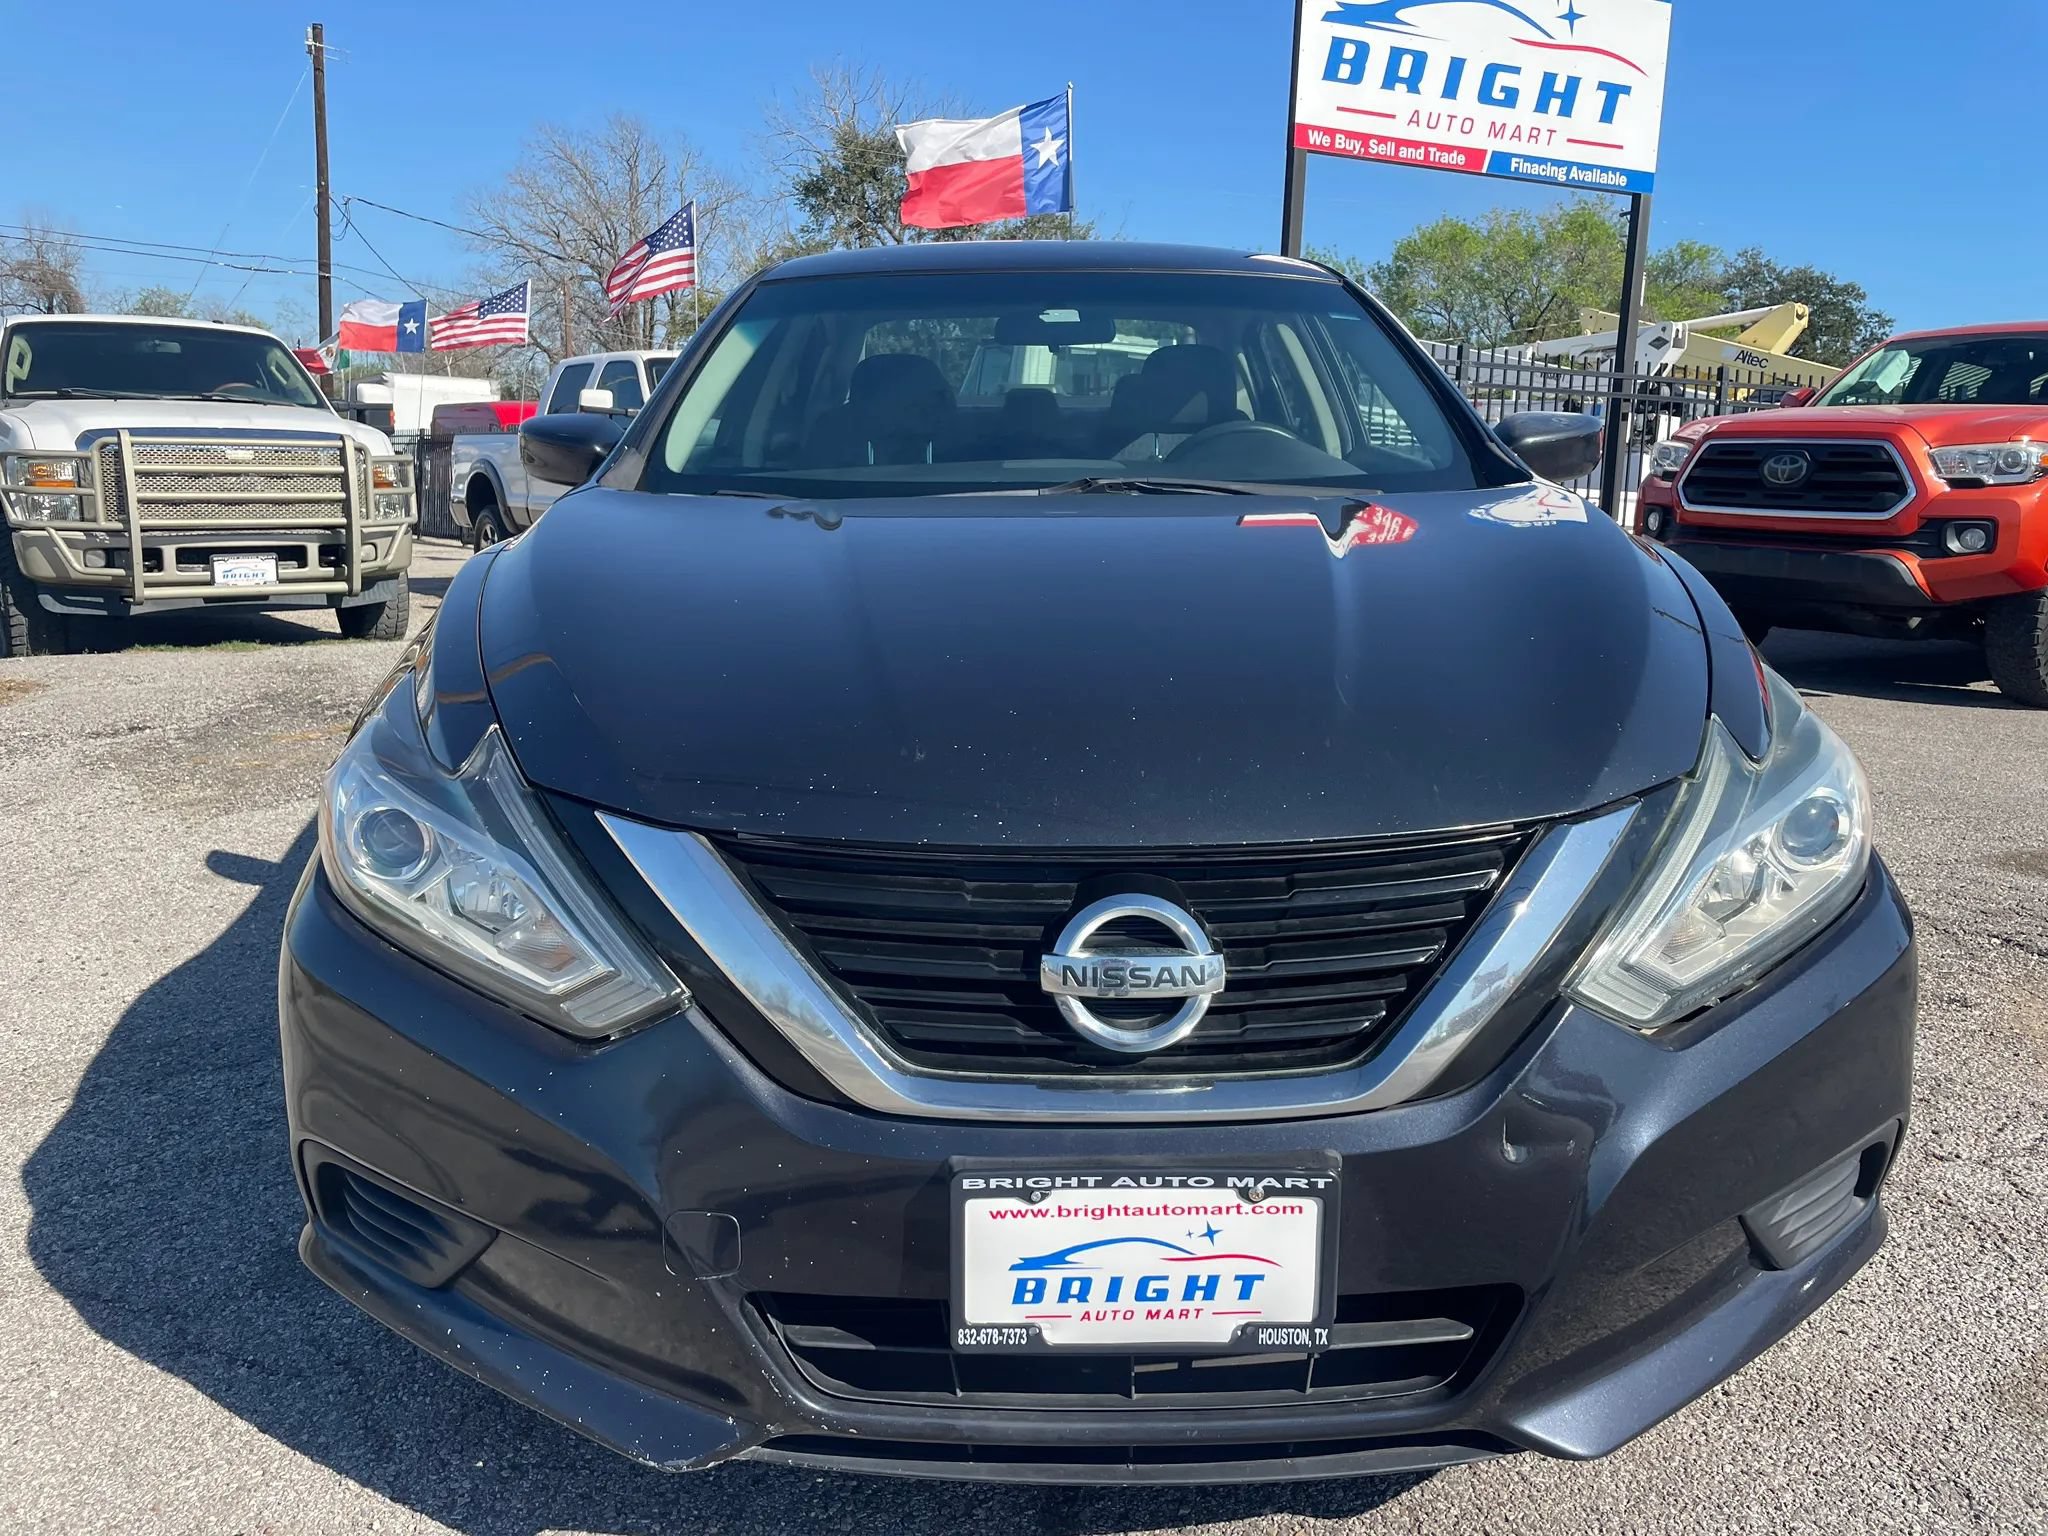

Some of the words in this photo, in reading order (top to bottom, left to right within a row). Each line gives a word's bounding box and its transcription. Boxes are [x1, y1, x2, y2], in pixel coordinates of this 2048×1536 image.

[1322, 35, 1632, 125] BRIGHT
[1407, 109, 1475, 135] AUTO
[1488, 121, 1557, 146] MART
[1307, 130, 1331, 147] We
[1335, 134, 1365, 155] Buy,
[1368, 138, 1395, 157] Sell
[1399, 142, 1424, 161] and
[1428, 145, 1466, 165] Trade
[1511, 157, 1566, 179] Finacing
[1569, 164, 1627, 187] Available
[1733, 349, 1769, 369] Altec
[1061, 964, 1206, 988] NISSAN
[962, 1176, 1103, 1190] BRIGHT
[1110, 1176, 1215, 1188] AUTO
[1226, 1176, 1333, 1189] MART
[988, 1203, 1303, 1221] www.brightautomart.com
[1011, 1273, 1266, 1305] BRIGHT
[1080, 1309, 1135, 1322] AUTO
[1145, 1308, 1204, 1321] MART
[957, 1328, 1028, 1345] 832-678-7373
[1258, 1328, 1313, 1346] HOUSTON,
[1315, 1328, 1329, 1344] TX
